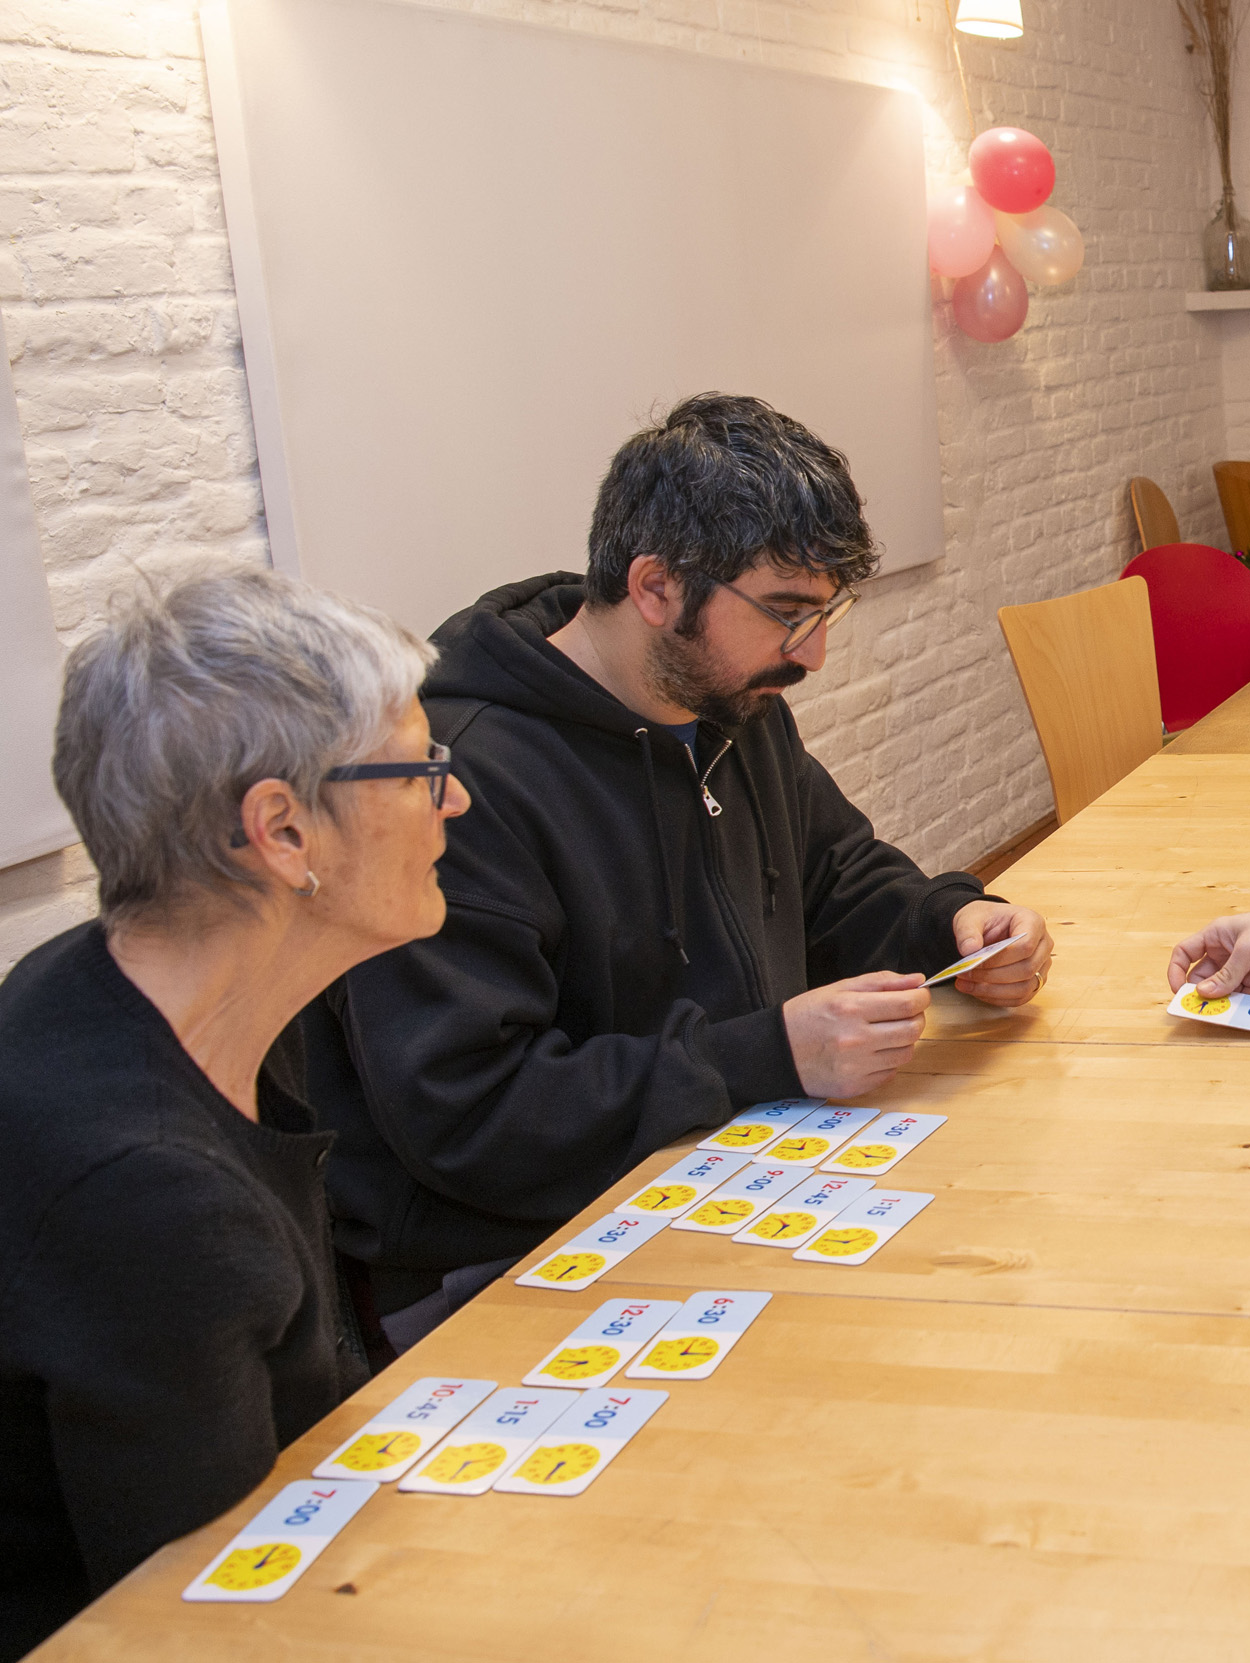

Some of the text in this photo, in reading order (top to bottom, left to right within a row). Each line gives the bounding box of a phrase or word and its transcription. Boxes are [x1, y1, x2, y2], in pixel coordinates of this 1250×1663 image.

[818, 1111, 851, 1129] 5:00
[885, 1118, 917, 1136] 4:30
[688, 1157, 723, 1176] 6:45
[746, 1171, 784, 1190] 9:00
[804, 1181, 848, 1204] 12:45
[867, 1199, 900, 1215] 1:15
[598, 1220, 639, 1242] 2:30
[602, 1305, 649, 1335] 12:30
[698, 1298, 734, 1323] 6:30
[406, 1384, 463, 1420] 10:45
[497, 1401, 538, 1424] 1:15
[585, 1398, 630, 1428] 7:00
[284, 1489, 337, 1526] 7:00
